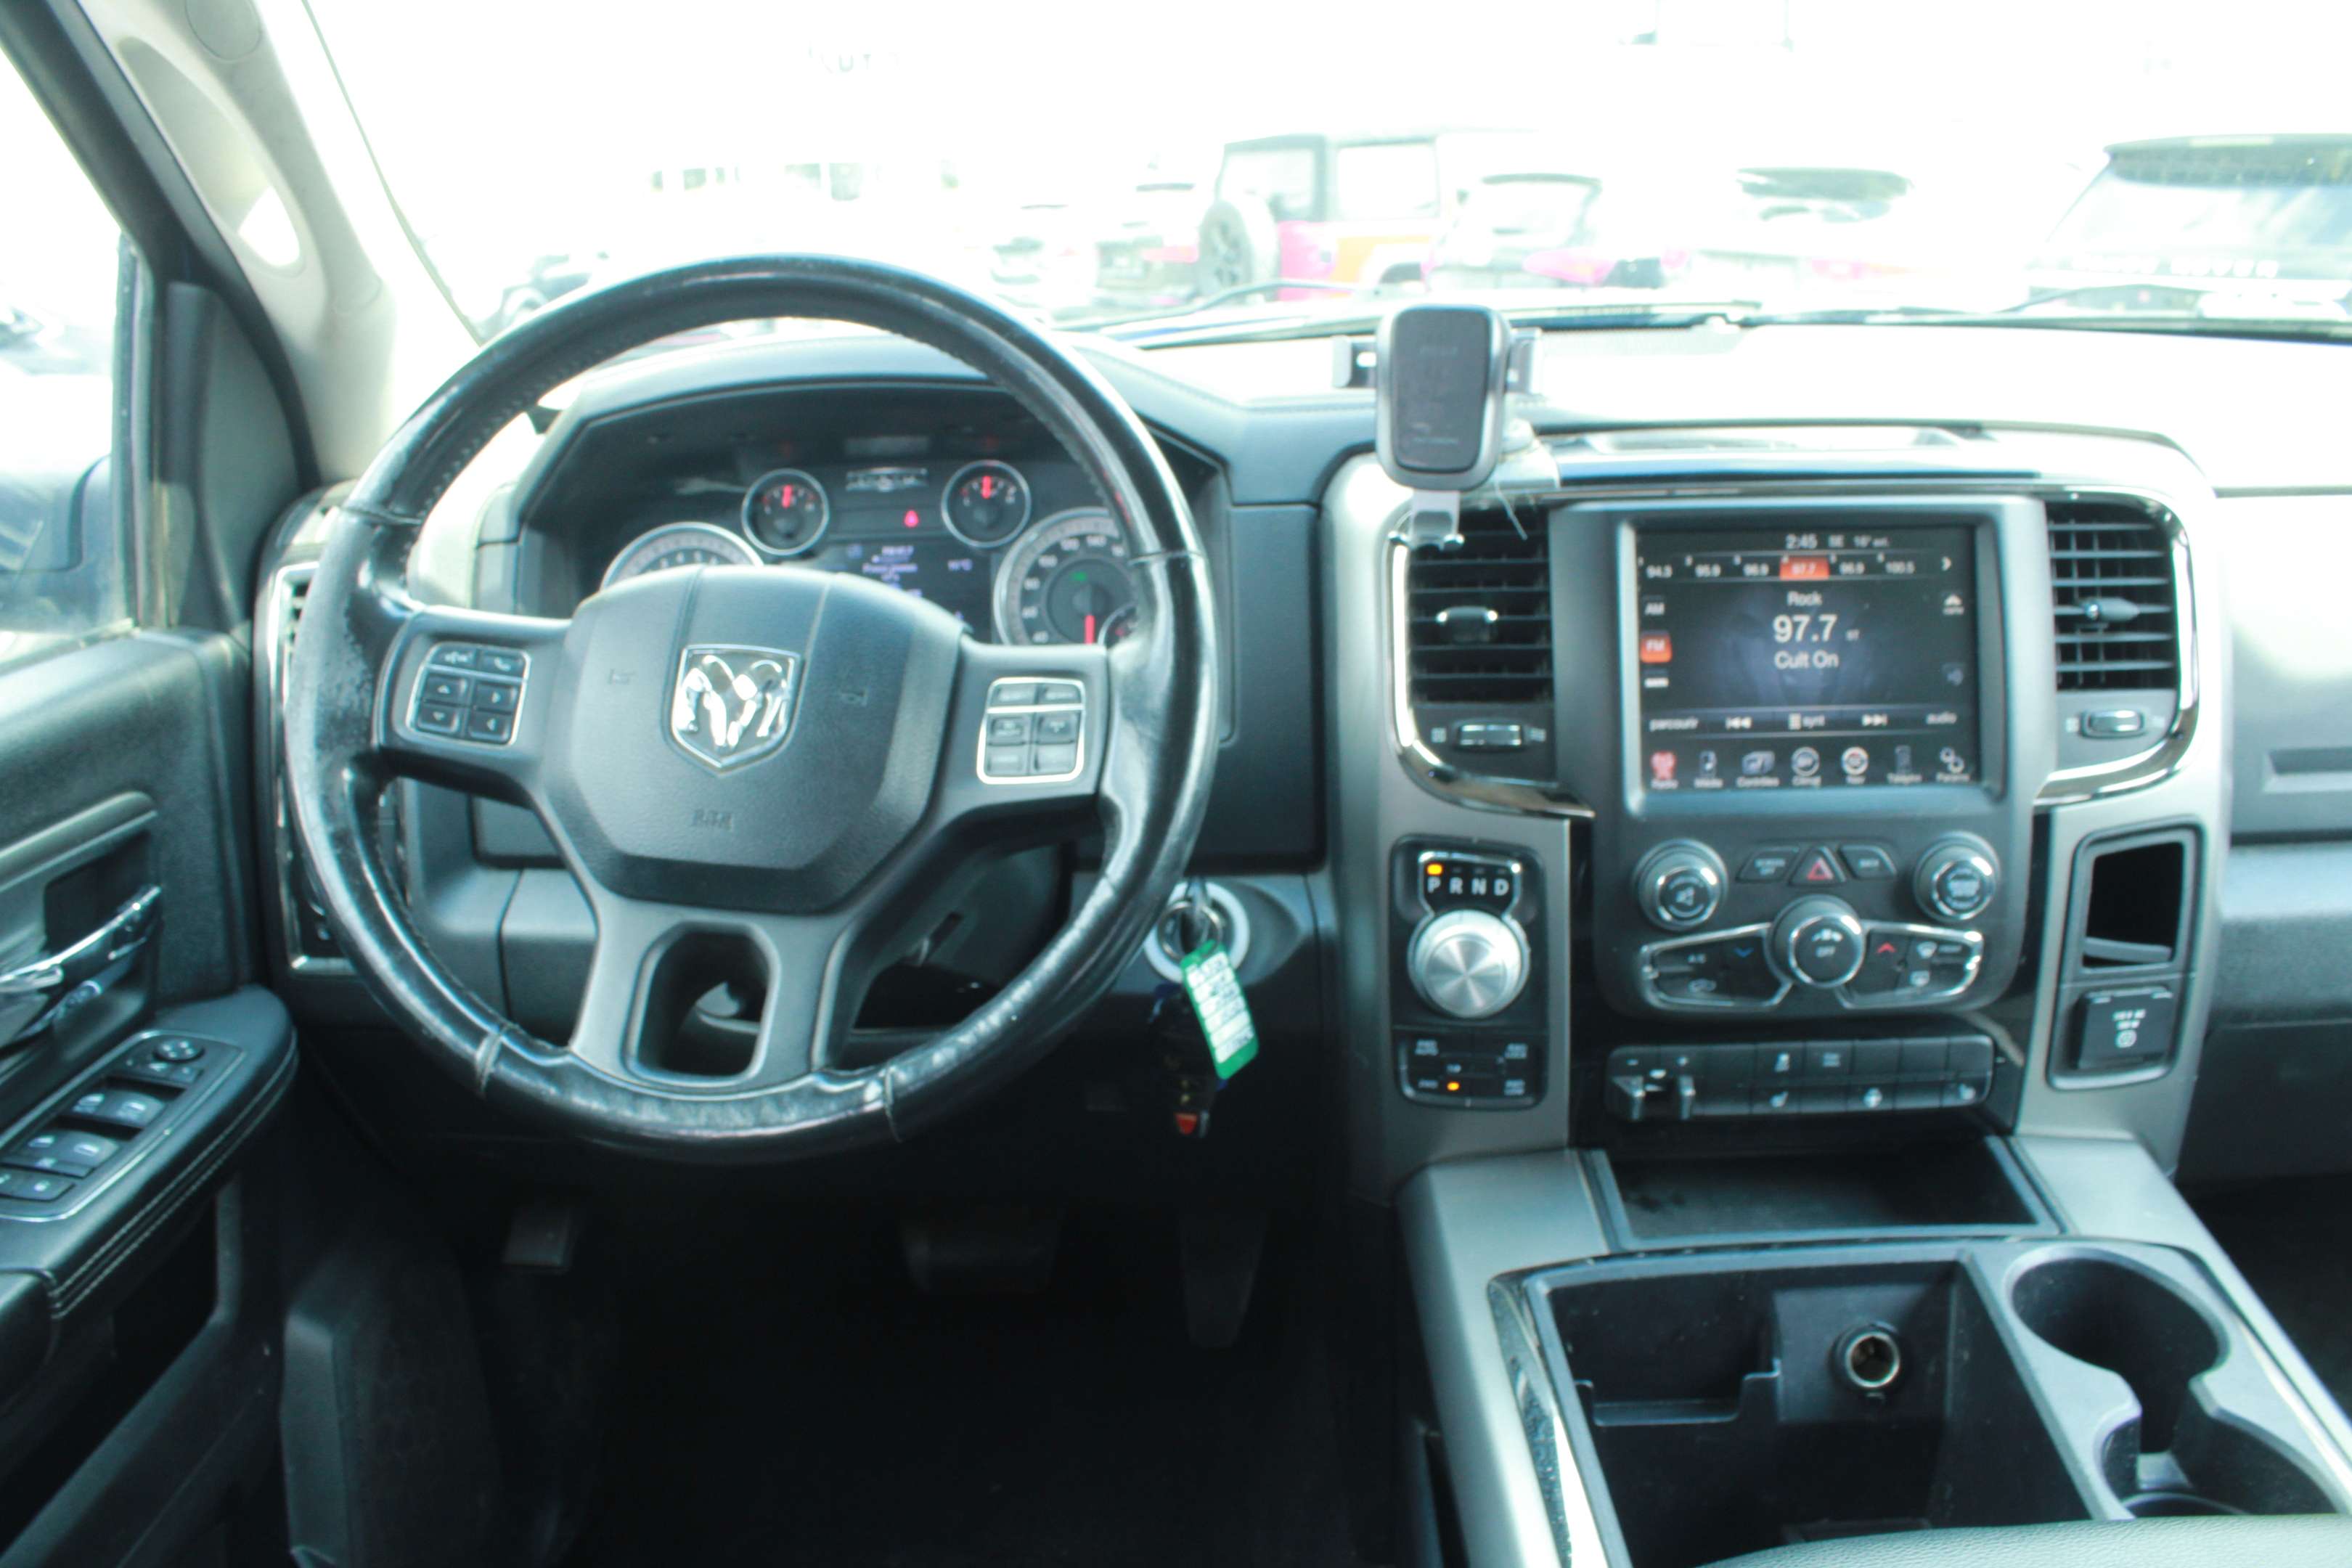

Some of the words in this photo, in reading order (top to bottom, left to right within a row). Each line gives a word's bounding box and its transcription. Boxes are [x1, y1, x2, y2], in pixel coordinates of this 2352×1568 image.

[1786, 534, 1818, 550] 2:45
[1792, 563, 1816, 576] 97.7
[1787, 591, 1823, 607] Rock
[1644, 603, 1665, 616] AM
[1773, 614, 1838, 642] 97.7
[1646, 639, 1665, 652] FM
[1813, 650, 1839, 669] On
[1926, 711, 1958, 725] audio
[1426, 876, 1442, 894] P
[1449, 877, 1463, 894] R
[1471, 878, 1487, 895] N
[1494, 879, 1510, 896] D
